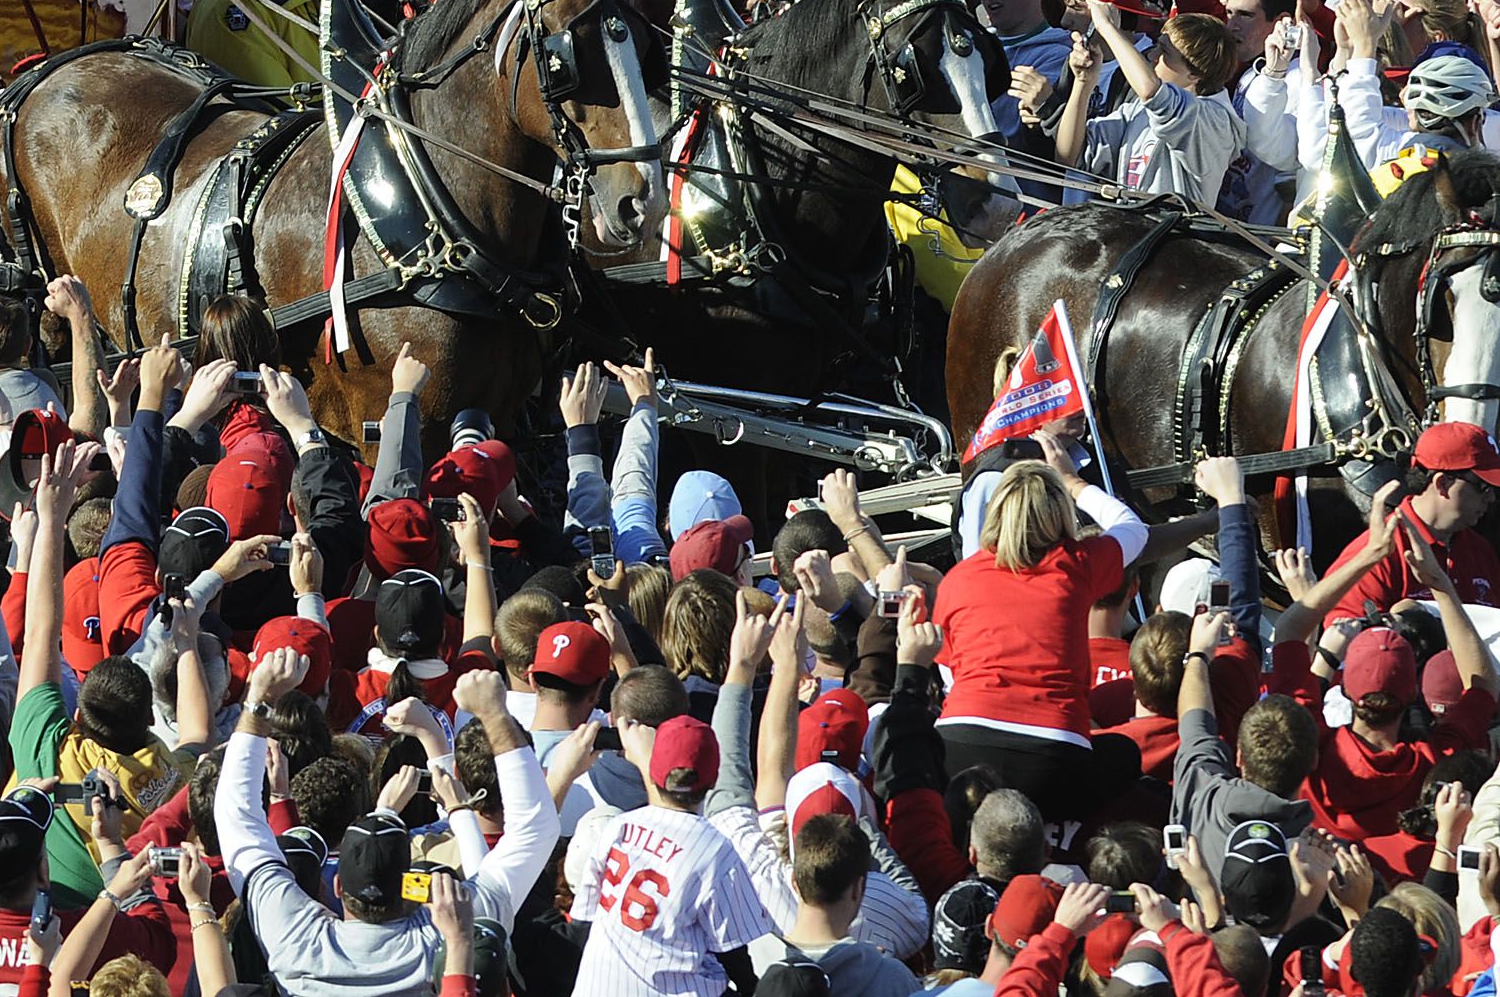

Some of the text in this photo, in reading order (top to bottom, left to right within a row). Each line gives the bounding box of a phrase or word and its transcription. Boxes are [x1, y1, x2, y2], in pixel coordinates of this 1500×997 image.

[996, 398, 1065, 427] CHAMPIONS
[552, 634, 571, 659] P
[622, 822, 683, 864] UTLEY
[599, 847, 670, 932] 26
